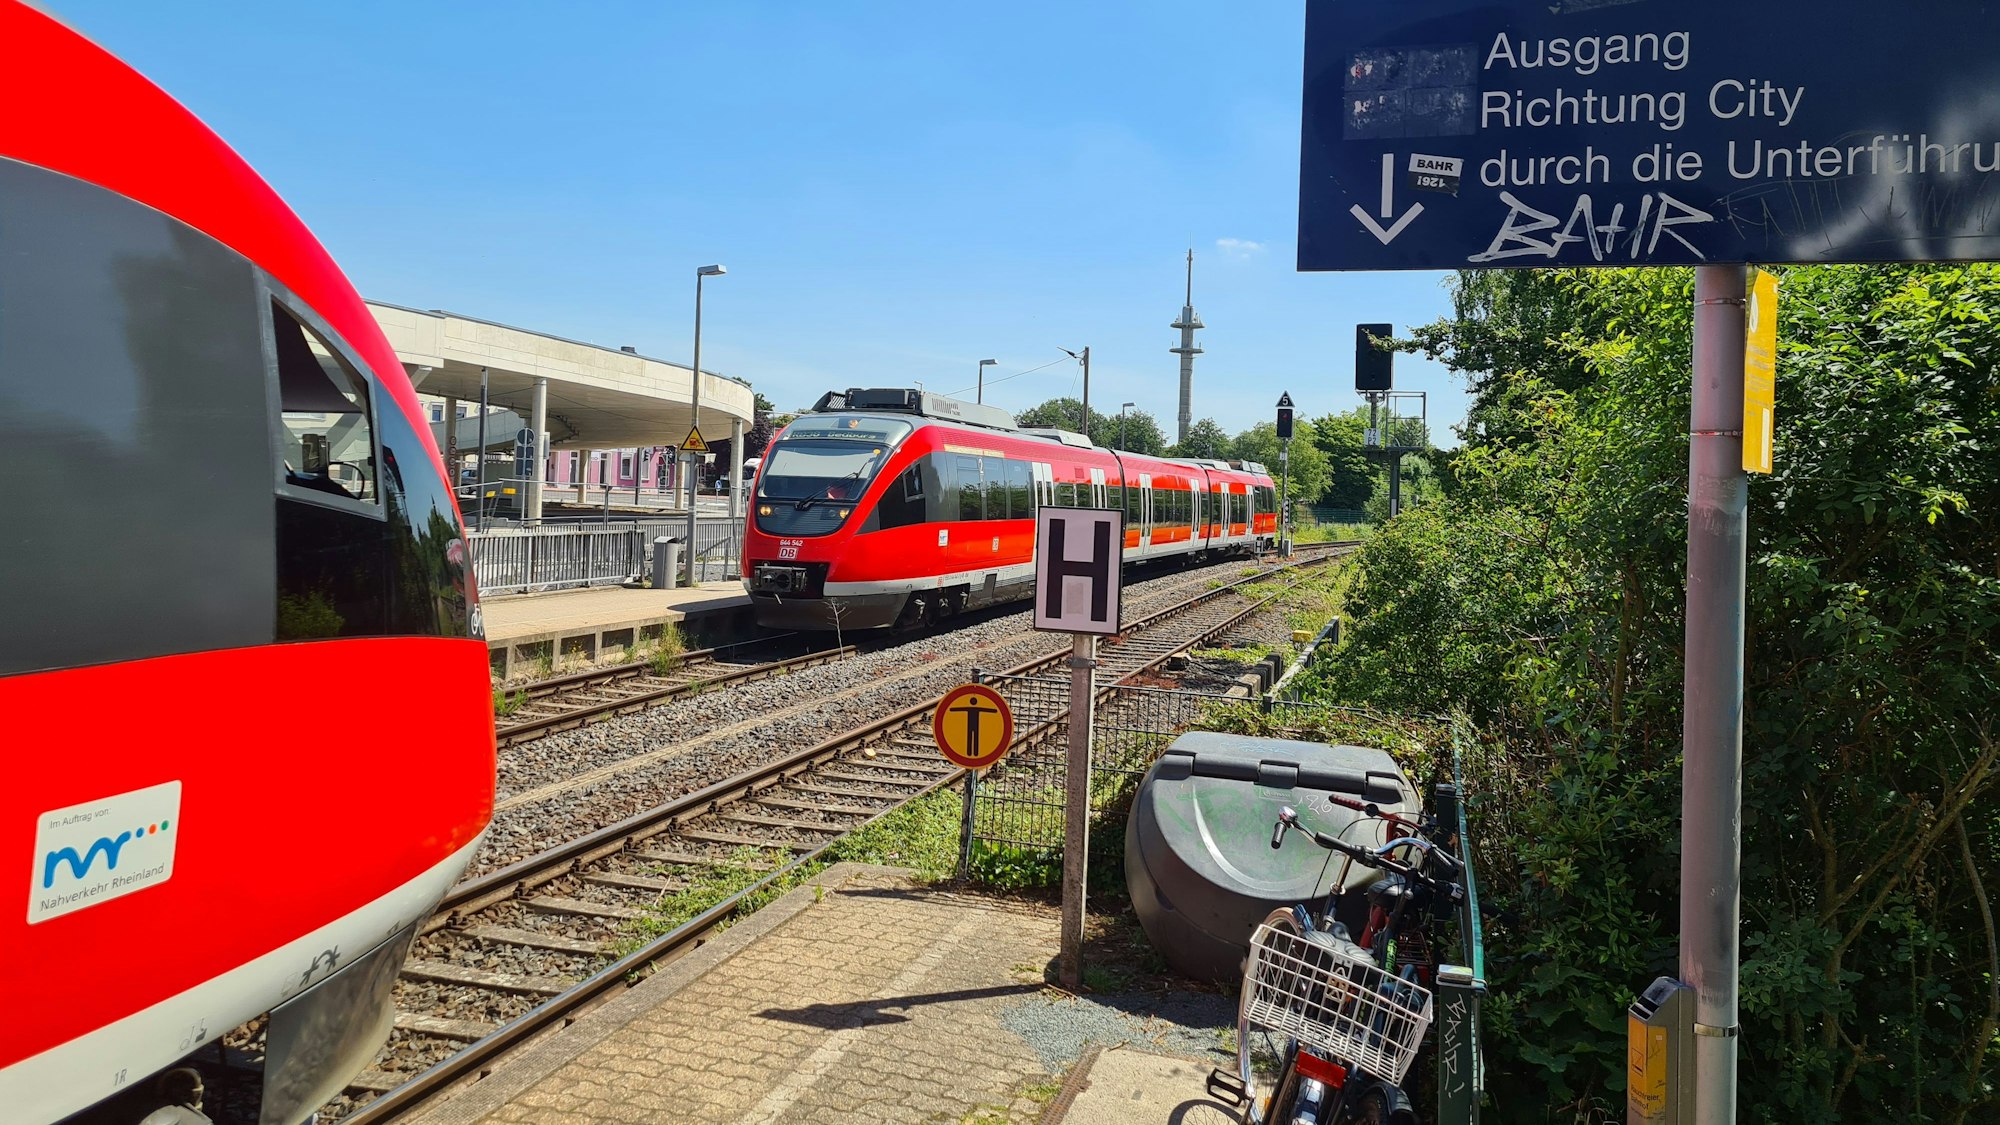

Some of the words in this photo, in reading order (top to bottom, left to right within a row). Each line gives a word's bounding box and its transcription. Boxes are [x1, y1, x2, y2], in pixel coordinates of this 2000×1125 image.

[1484, 30, 1691, 75] Ausgang
[1480, 86, 1686, 133] Richtung
[1707, 78, 1806, 127] City
[1416, 158, 1455, 173] BAHR
[1478, 145, 1611, 187] durch
[1631, 141, 1703, 183] die
[1727, 134, 2000, 180] Unterführu
[1416, 175, 1447, 188] 126!
[1282, 396, 1289, 406] 5
[780, 548, 795, 558] DB
[1255, 541, 1262, 552] H
[1046, 519, 1111, 622] H
[49, 820, 61, 830] Im
[62, 811, 93, 827] Auftrag
[44, 830, 132, 889] nvr
[39, 882, 109, 912] Nahverkehr
[111, 862, 165, 889] Rheinland
[114, 1068, 127, 1086] 1R
